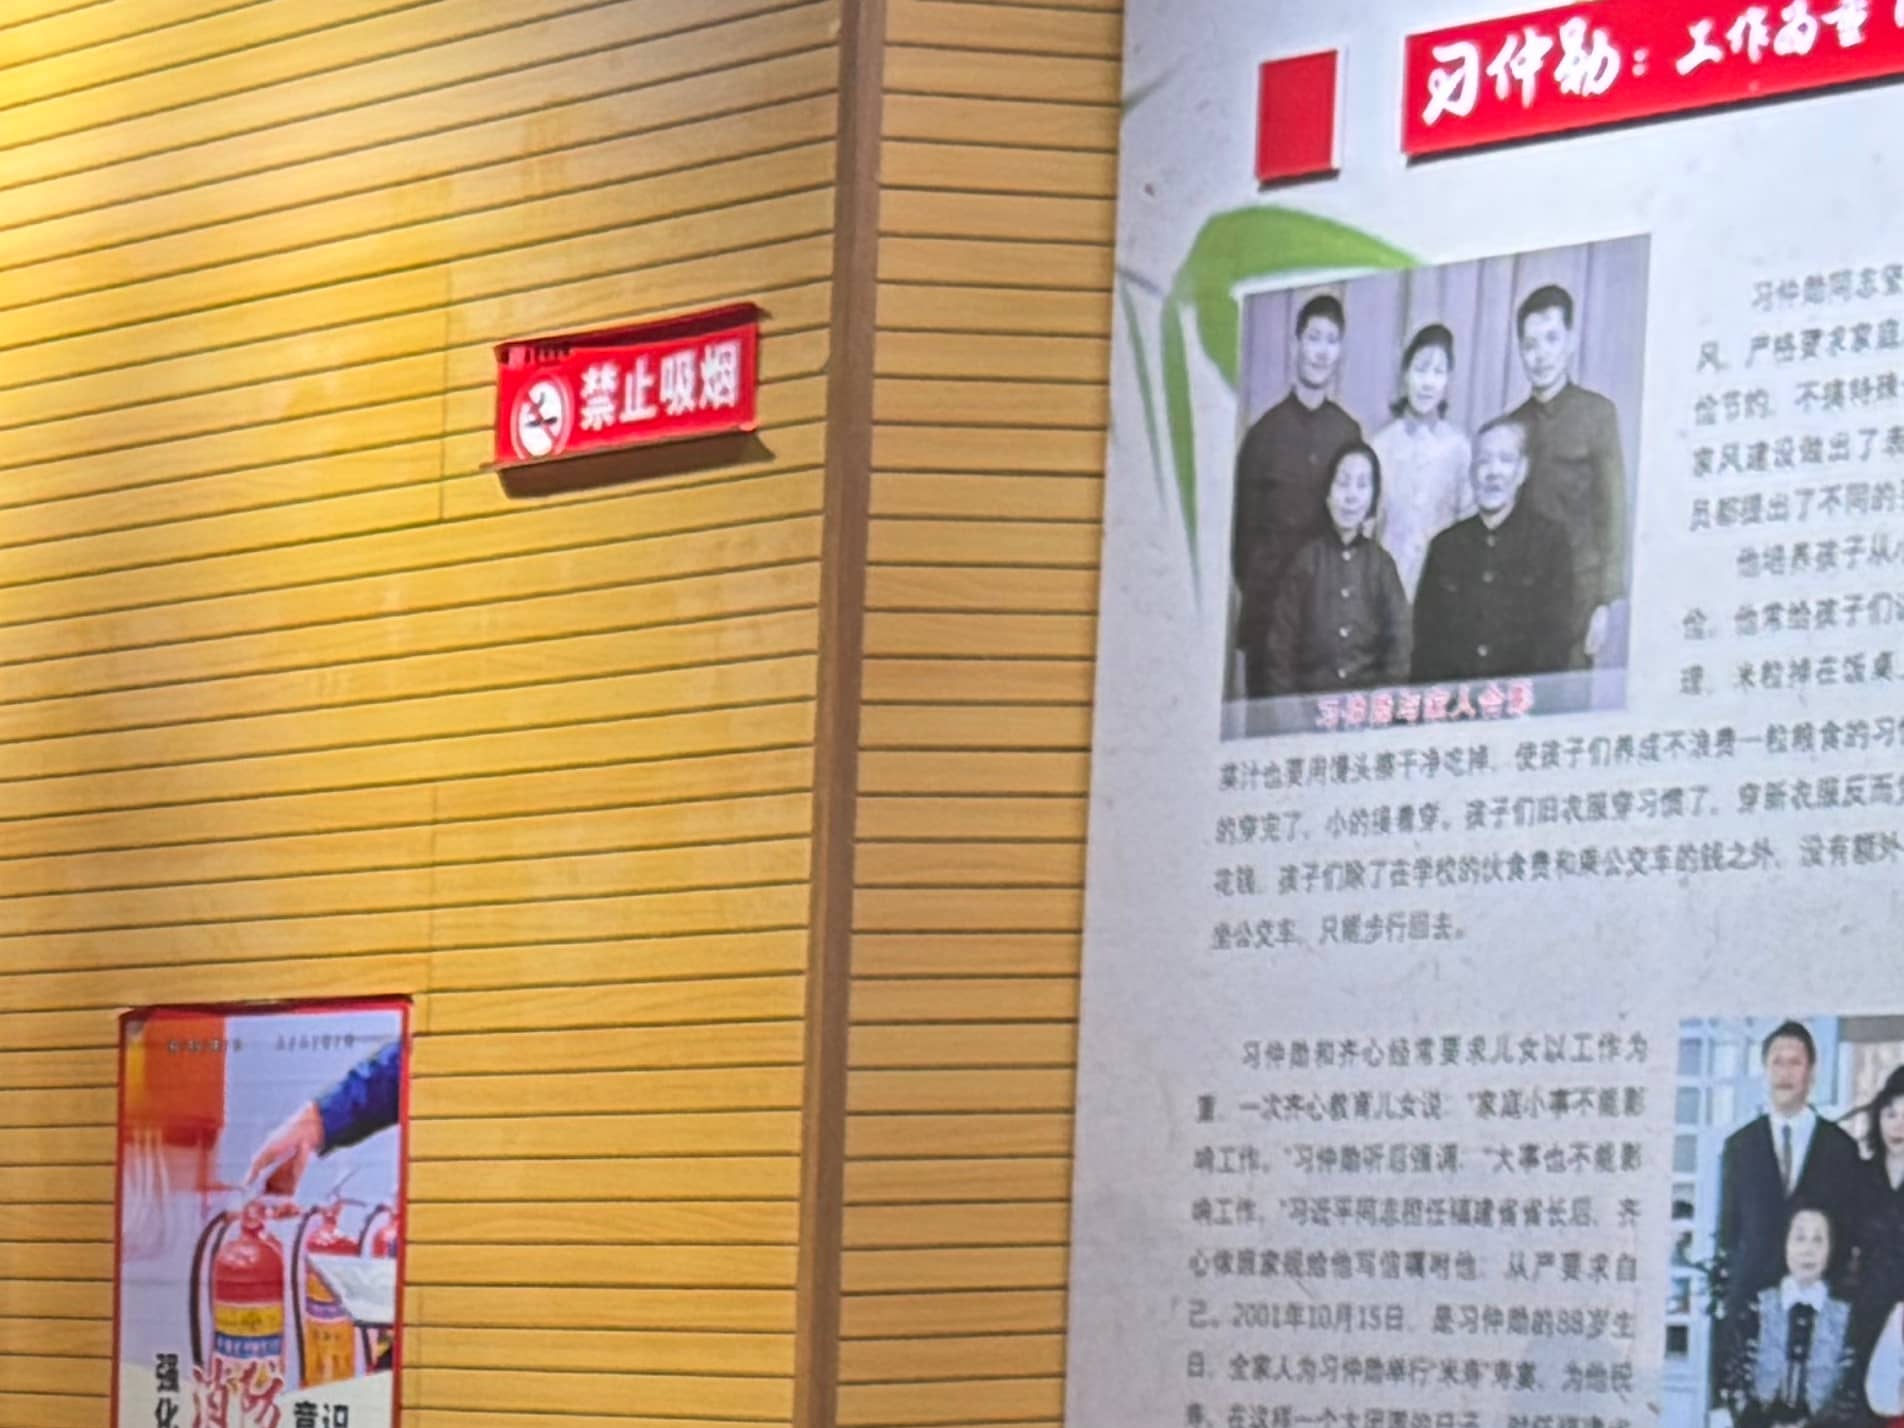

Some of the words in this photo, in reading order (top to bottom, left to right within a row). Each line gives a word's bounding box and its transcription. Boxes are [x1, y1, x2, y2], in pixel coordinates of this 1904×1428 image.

[1422, 0, 1904, 127] 习仲勋：工作为重
[578, 338, 742, 432] 禁止吸烟
[1690, 480, 1904, 531] 员都提出了不同的
